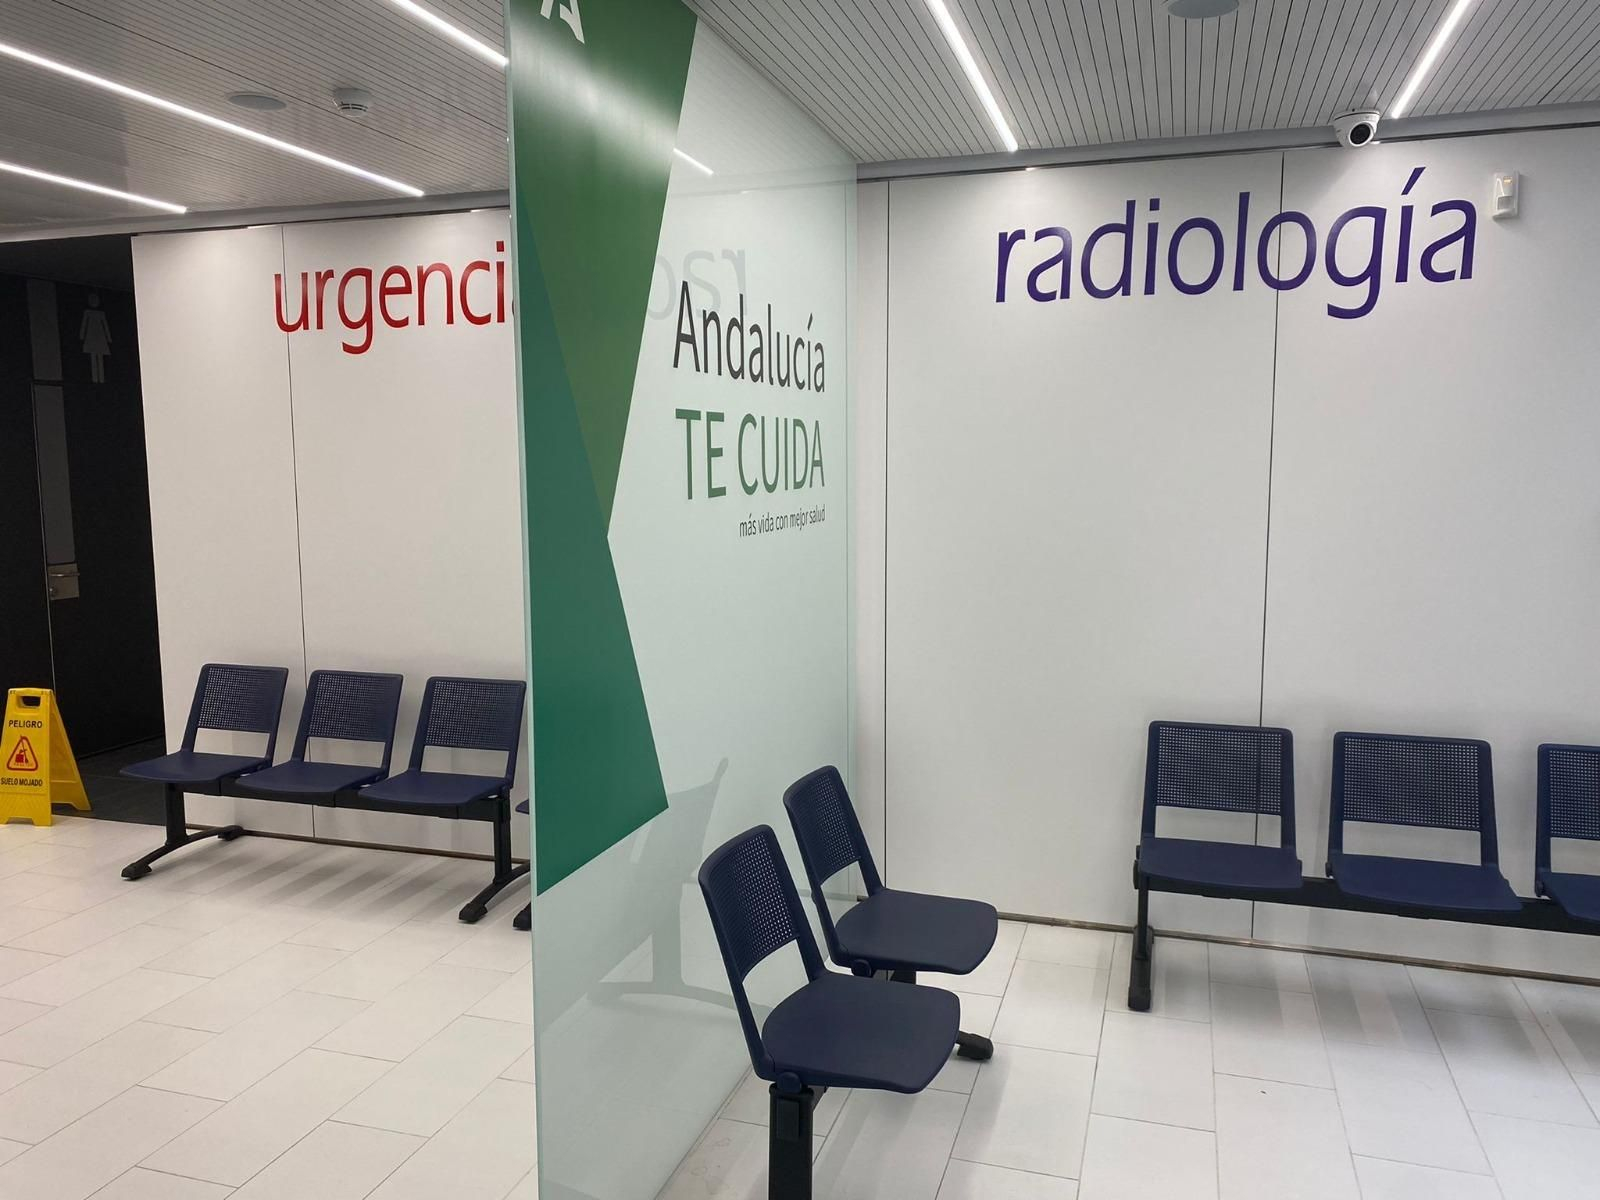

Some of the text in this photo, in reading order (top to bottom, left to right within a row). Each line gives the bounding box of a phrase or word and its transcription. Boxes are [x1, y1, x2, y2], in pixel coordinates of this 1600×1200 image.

[995, 166, 1478, 319] radiología
[274, 240, 514, 354] urgenci
[673, 280, 825, 393] Andalucía
[675, 408, 825, 500] TE CUIDA
[739, 504, 825, 538] más vida con mejor salud
[8, 719, 43, 729] PELIGRO
[0, 777, 43, 787] SUELO MOJADO
